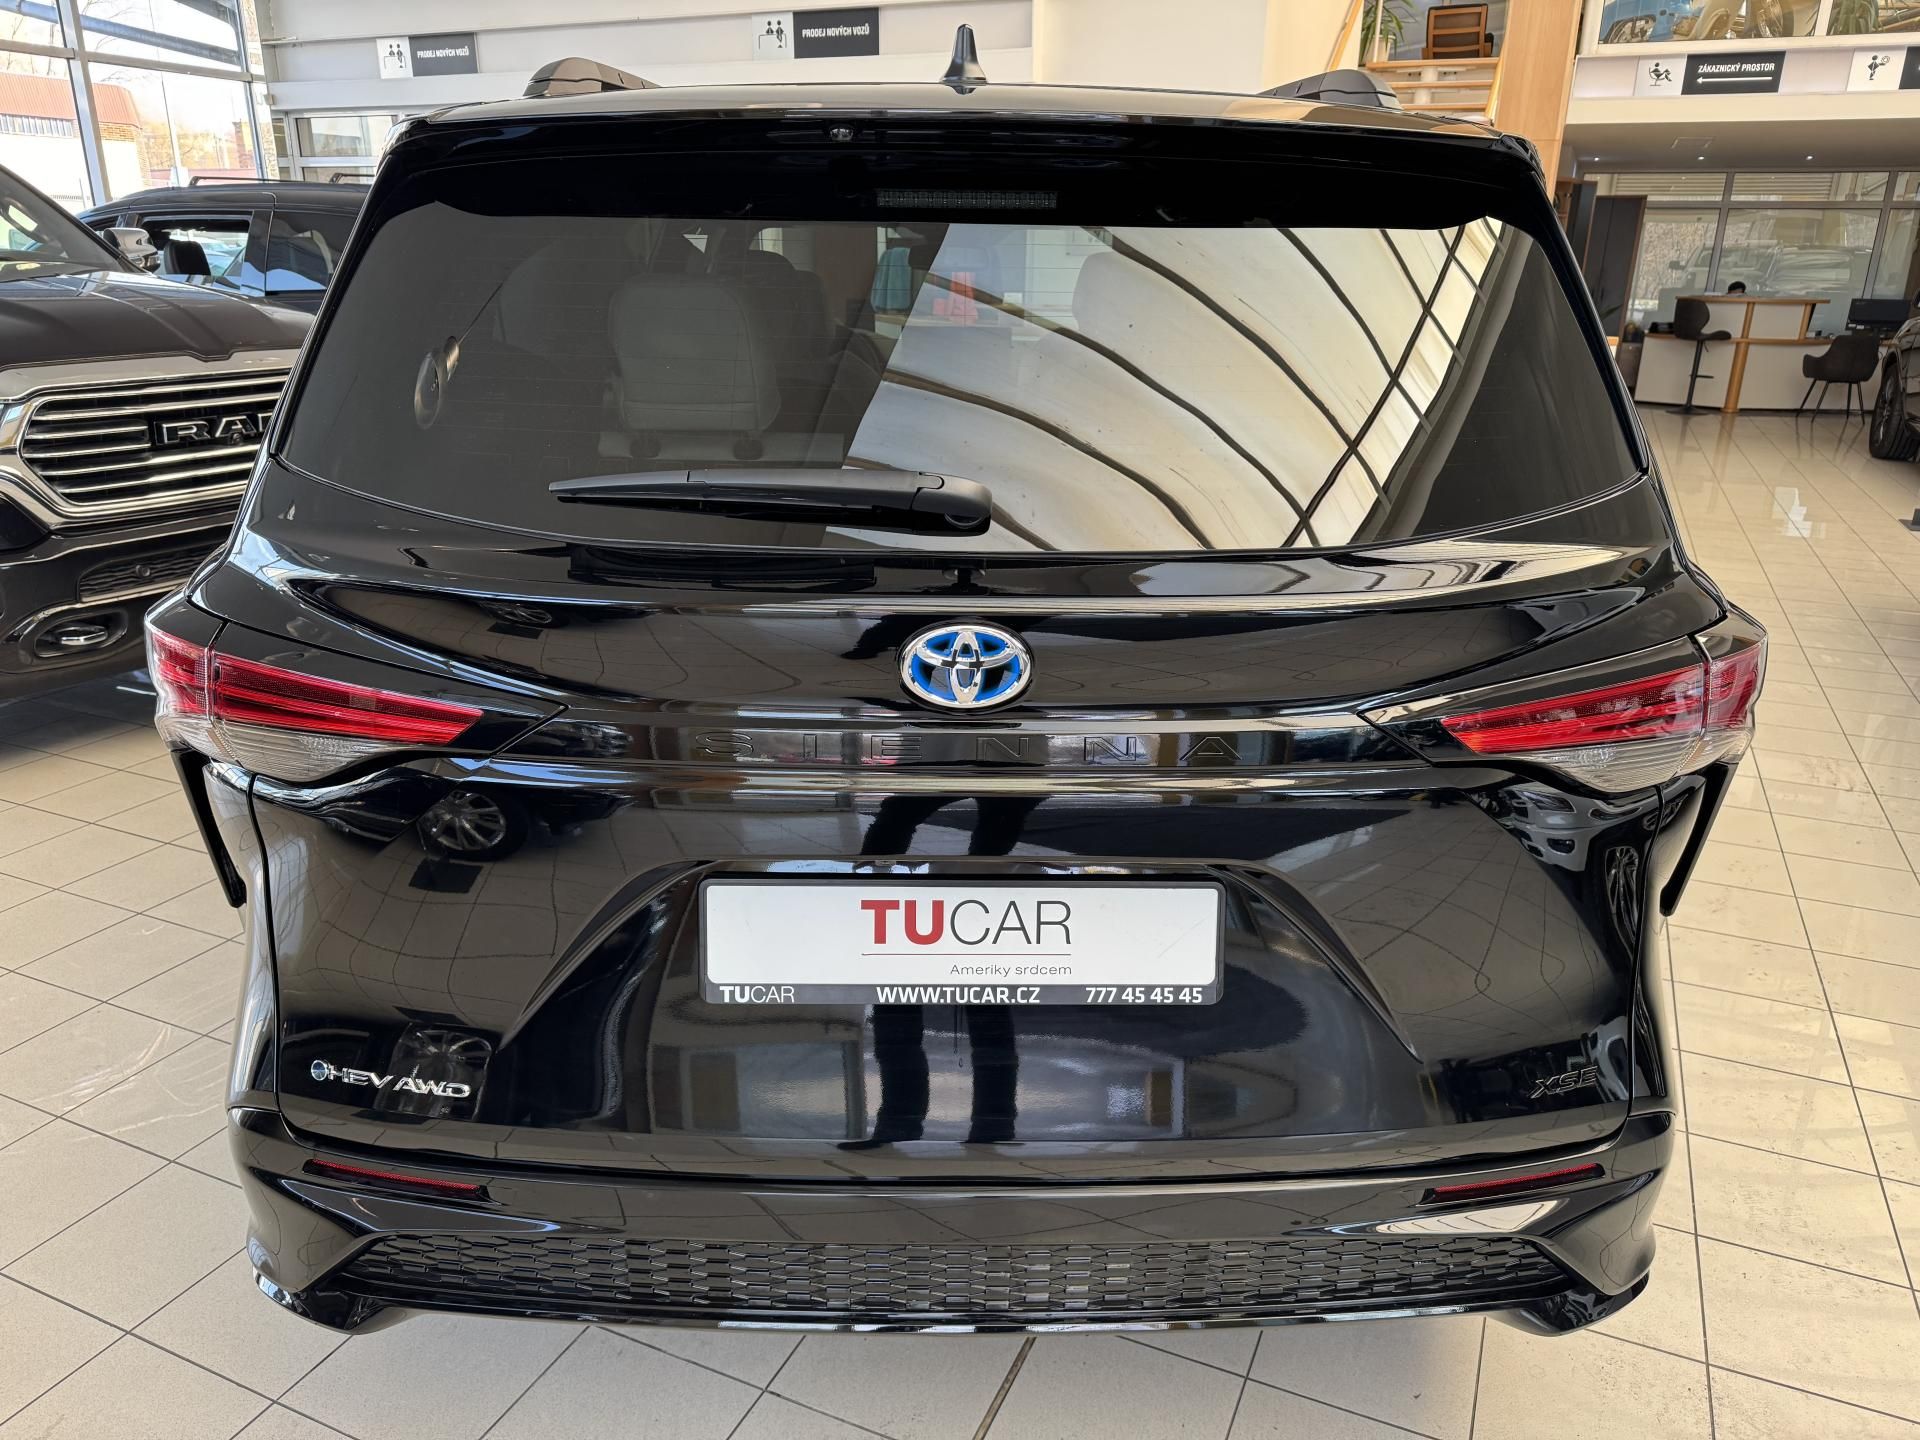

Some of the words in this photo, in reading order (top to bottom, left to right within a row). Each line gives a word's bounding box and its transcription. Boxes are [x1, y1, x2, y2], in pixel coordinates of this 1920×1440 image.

[802, 28, 826, 38] PRODEJ
[826, 25, 852, 37] NOVÝCH
[852, 23, 869, 36] VOZŮ
[417, 50, 435, 58] PRODEJ
[436, 47, 455, 57] NOVÝCH
[455, 45, 469, 56] VOZŮ
[1697, 62, 1741, 73] ZÁKAZNICKÝ
[1741, 62, 1775, 72] PROSTOR
[696, 731, 1242, 761] SIENNA
[861, 899, 1072, 945] TUCAR
[950, 964, 1011, 977] Ameriky
[1015, 964, 1072, 975] srdcem
[719, 985, 795, 1003] TUCAR
[876, 986, 1041, 1004] WWW.TUCAR.CZ
[1085, 987, 1118, 1003] 777
[1121, 987, 1145, 1003] 45
[1150, 987, 1174, 1003] 45
[1178, 987, 1203, 1003] 45
[393, 1075, 471, 1099] AWD
[1528, 1066, 1598, 1099] XSE
